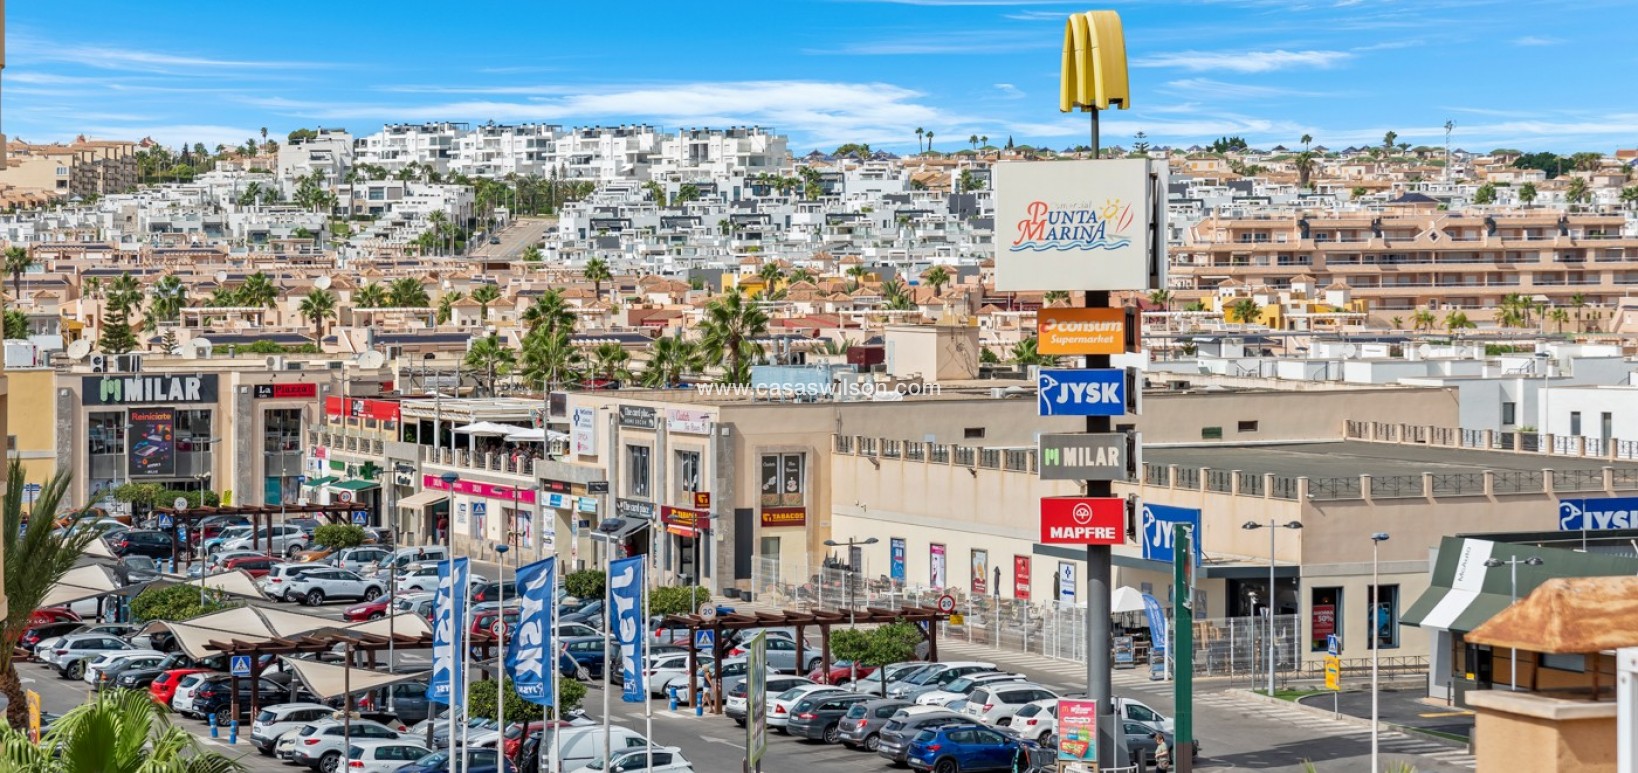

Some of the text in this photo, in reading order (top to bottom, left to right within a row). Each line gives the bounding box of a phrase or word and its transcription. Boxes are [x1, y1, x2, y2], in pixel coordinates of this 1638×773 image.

[1027, 201, 1098, 226] PUNTA
[1013, 219, 1107, 246] MARINA
[1051, 333, 1115, 345] Supermarket
[124, 377, 201, 401] MILAR
[1056, 382, 1121, 404] JYSK
[1063, 446, 1120, 467] MILAR
[177, 500, 185, 508] 20
[772, 512, 804, 520] TABACOS
[1050, 527, 1116, 539] MAPFRE
[1457, 546, 1472, 582] McAuto
